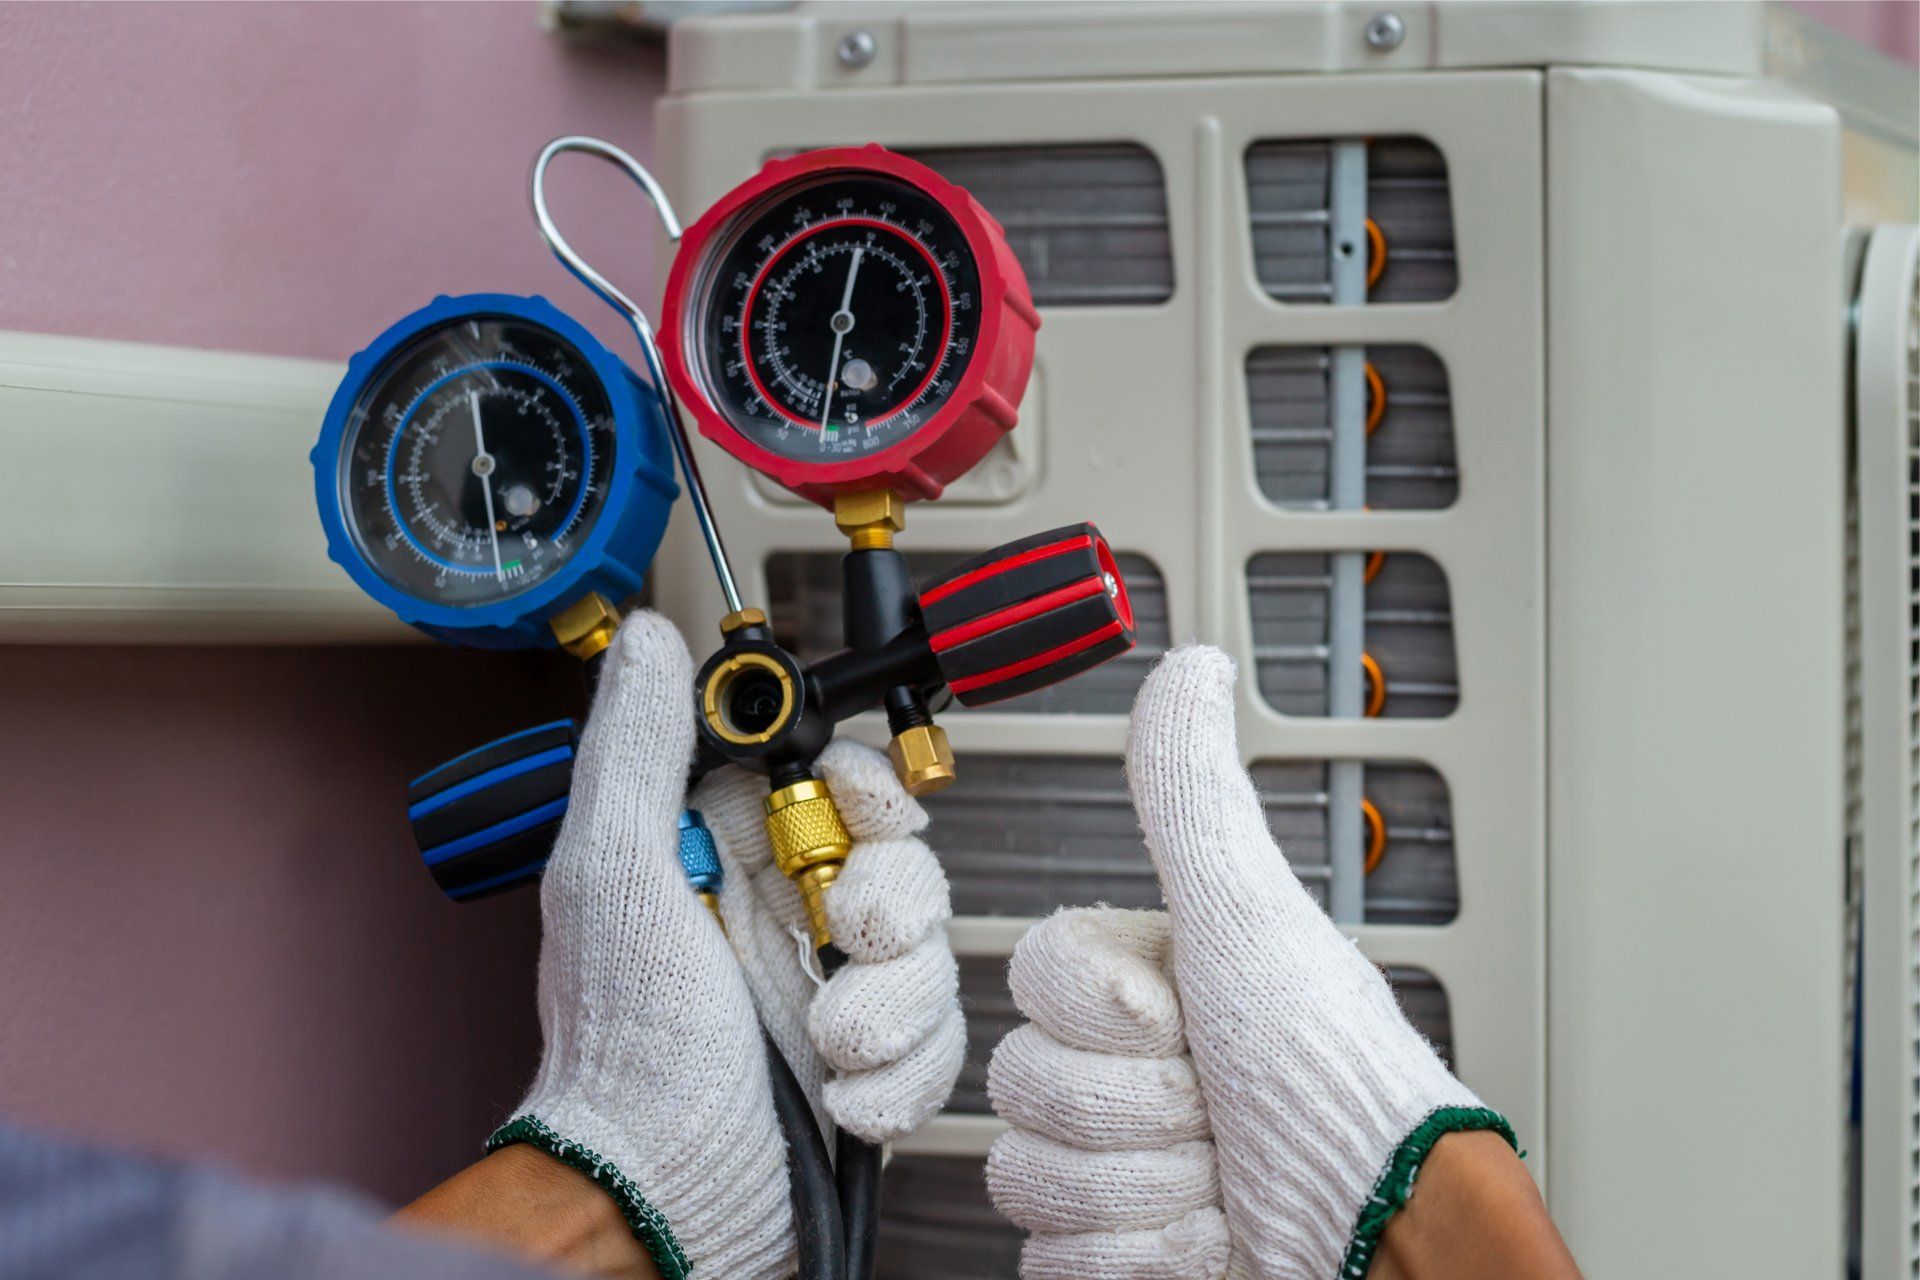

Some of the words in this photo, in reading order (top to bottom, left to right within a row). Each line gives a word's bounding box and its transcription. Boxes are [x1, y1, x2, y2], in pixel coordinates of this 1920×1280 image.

[960, 292, 972, 310] 600
[956, 337, 970, 355] 650
[936, 379, 953, 398] 700
[902, 414, 921, 430] 750
[862, 436, 880, 449] 800
